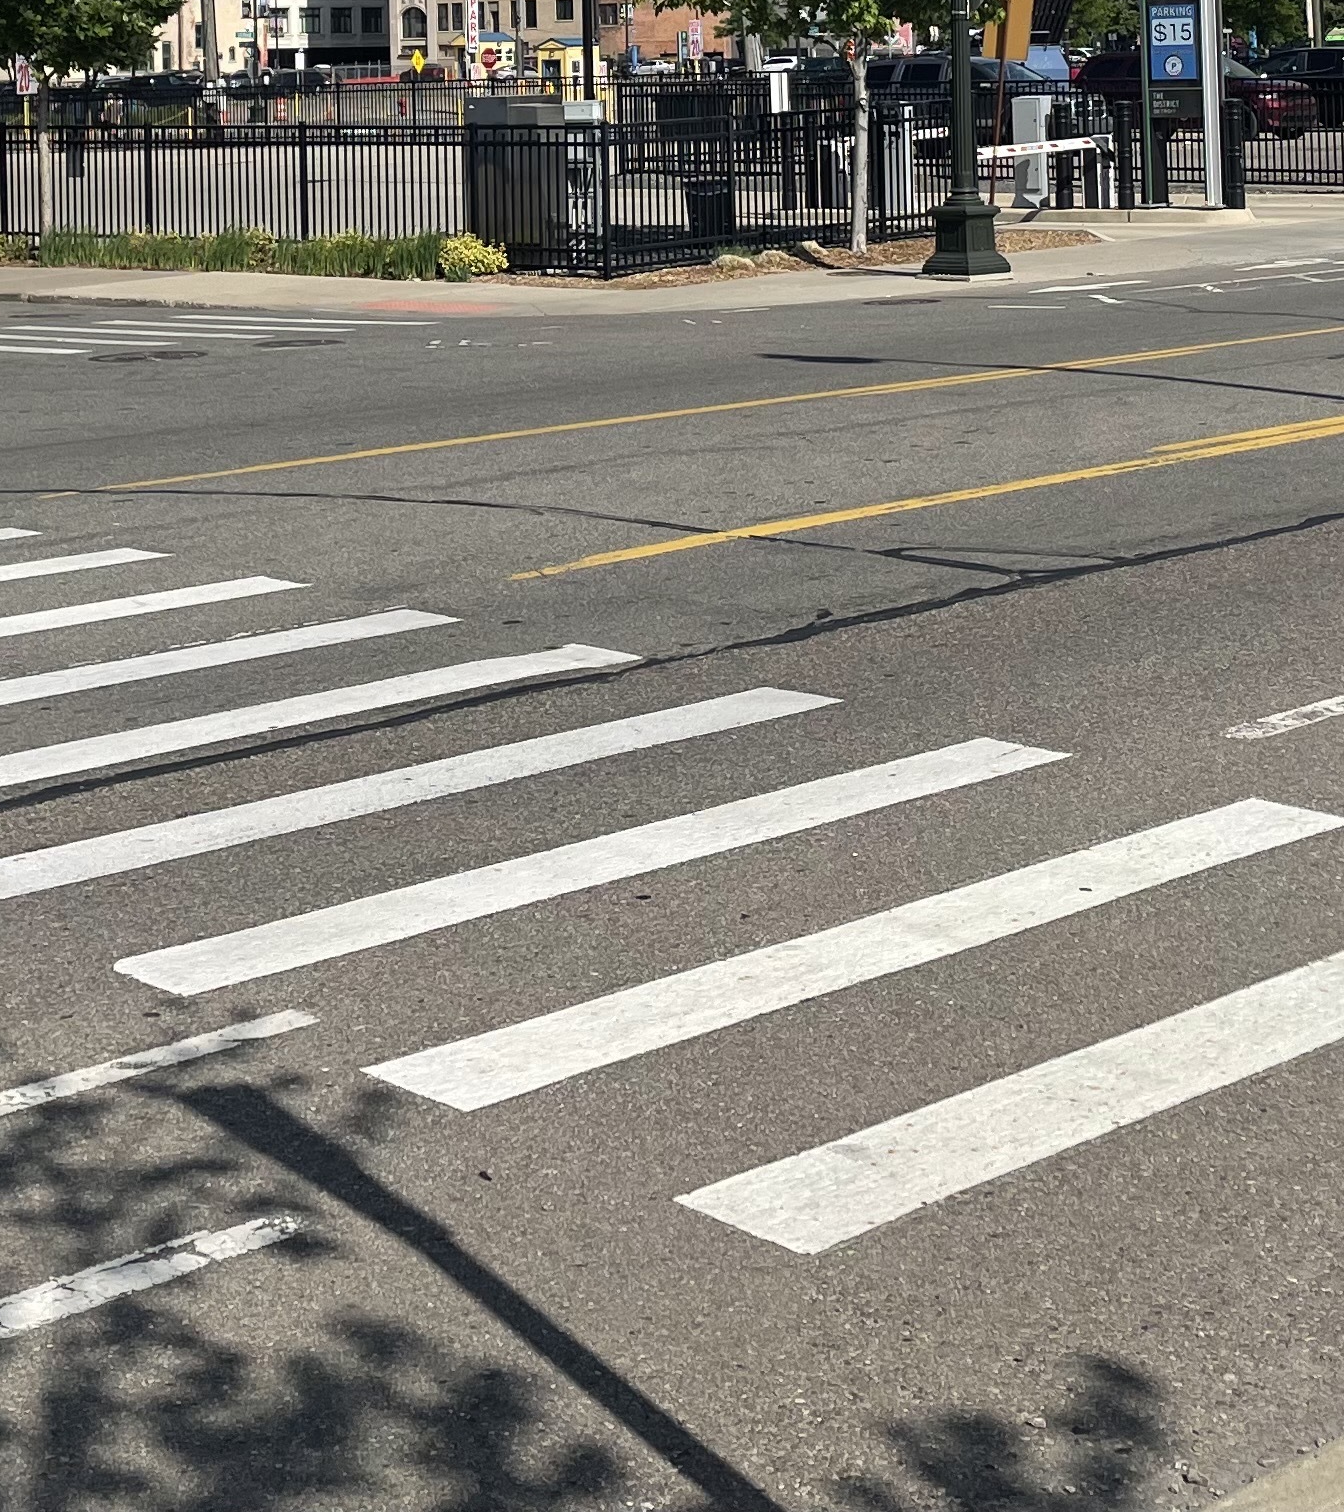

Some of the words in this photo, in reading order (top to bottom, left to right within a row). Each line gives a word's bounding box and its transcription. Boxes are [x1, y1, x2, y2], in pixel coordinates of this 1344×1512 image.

[1151, 6, 1193, 17] PARKING
[1153, 22, 1192, 43] $15
[481, 54, 496, 63] STOP
